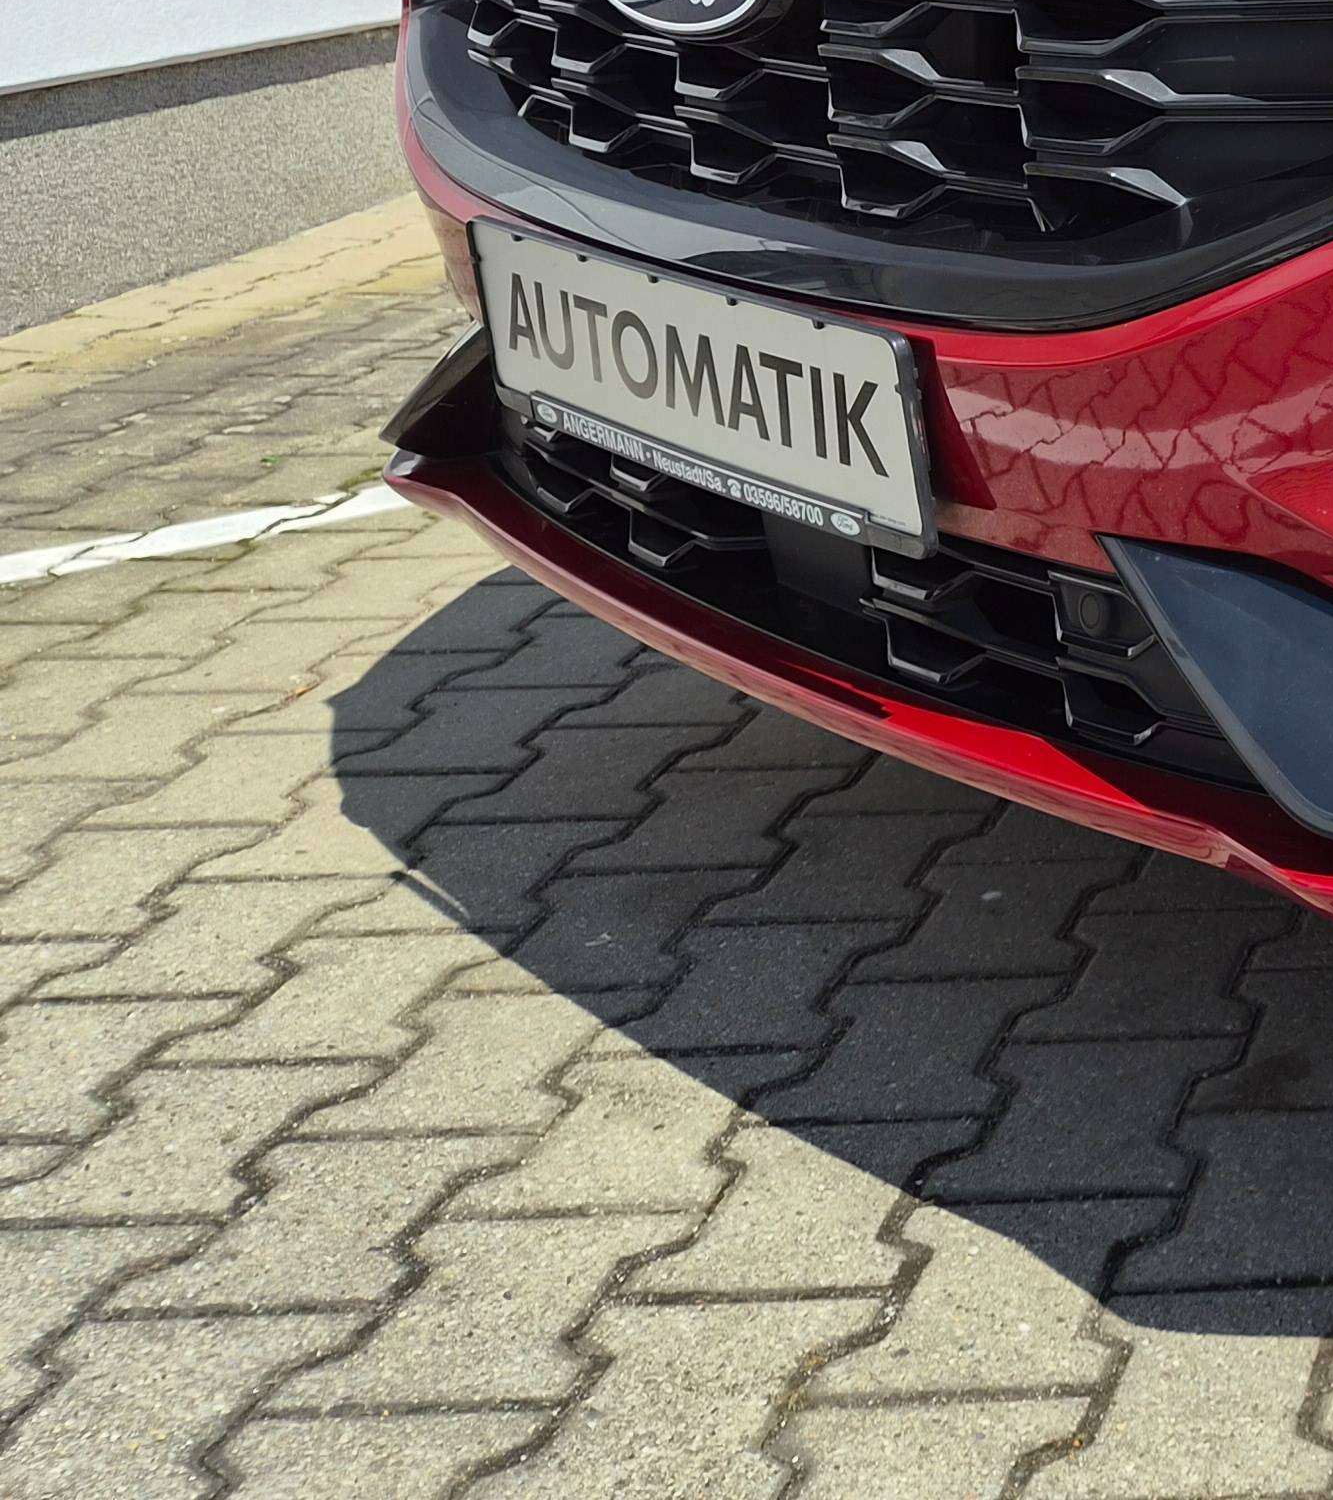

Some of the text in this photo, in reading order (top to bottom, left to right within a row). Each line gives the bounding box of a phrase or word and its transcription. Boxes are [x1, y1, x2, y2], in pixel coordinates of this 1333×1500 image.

[508, 272, 889, 478] AUTOMATIK
[562, 411, 646, 462] ANGERMANN
[743, 483, 824, 527] 03596/58700
